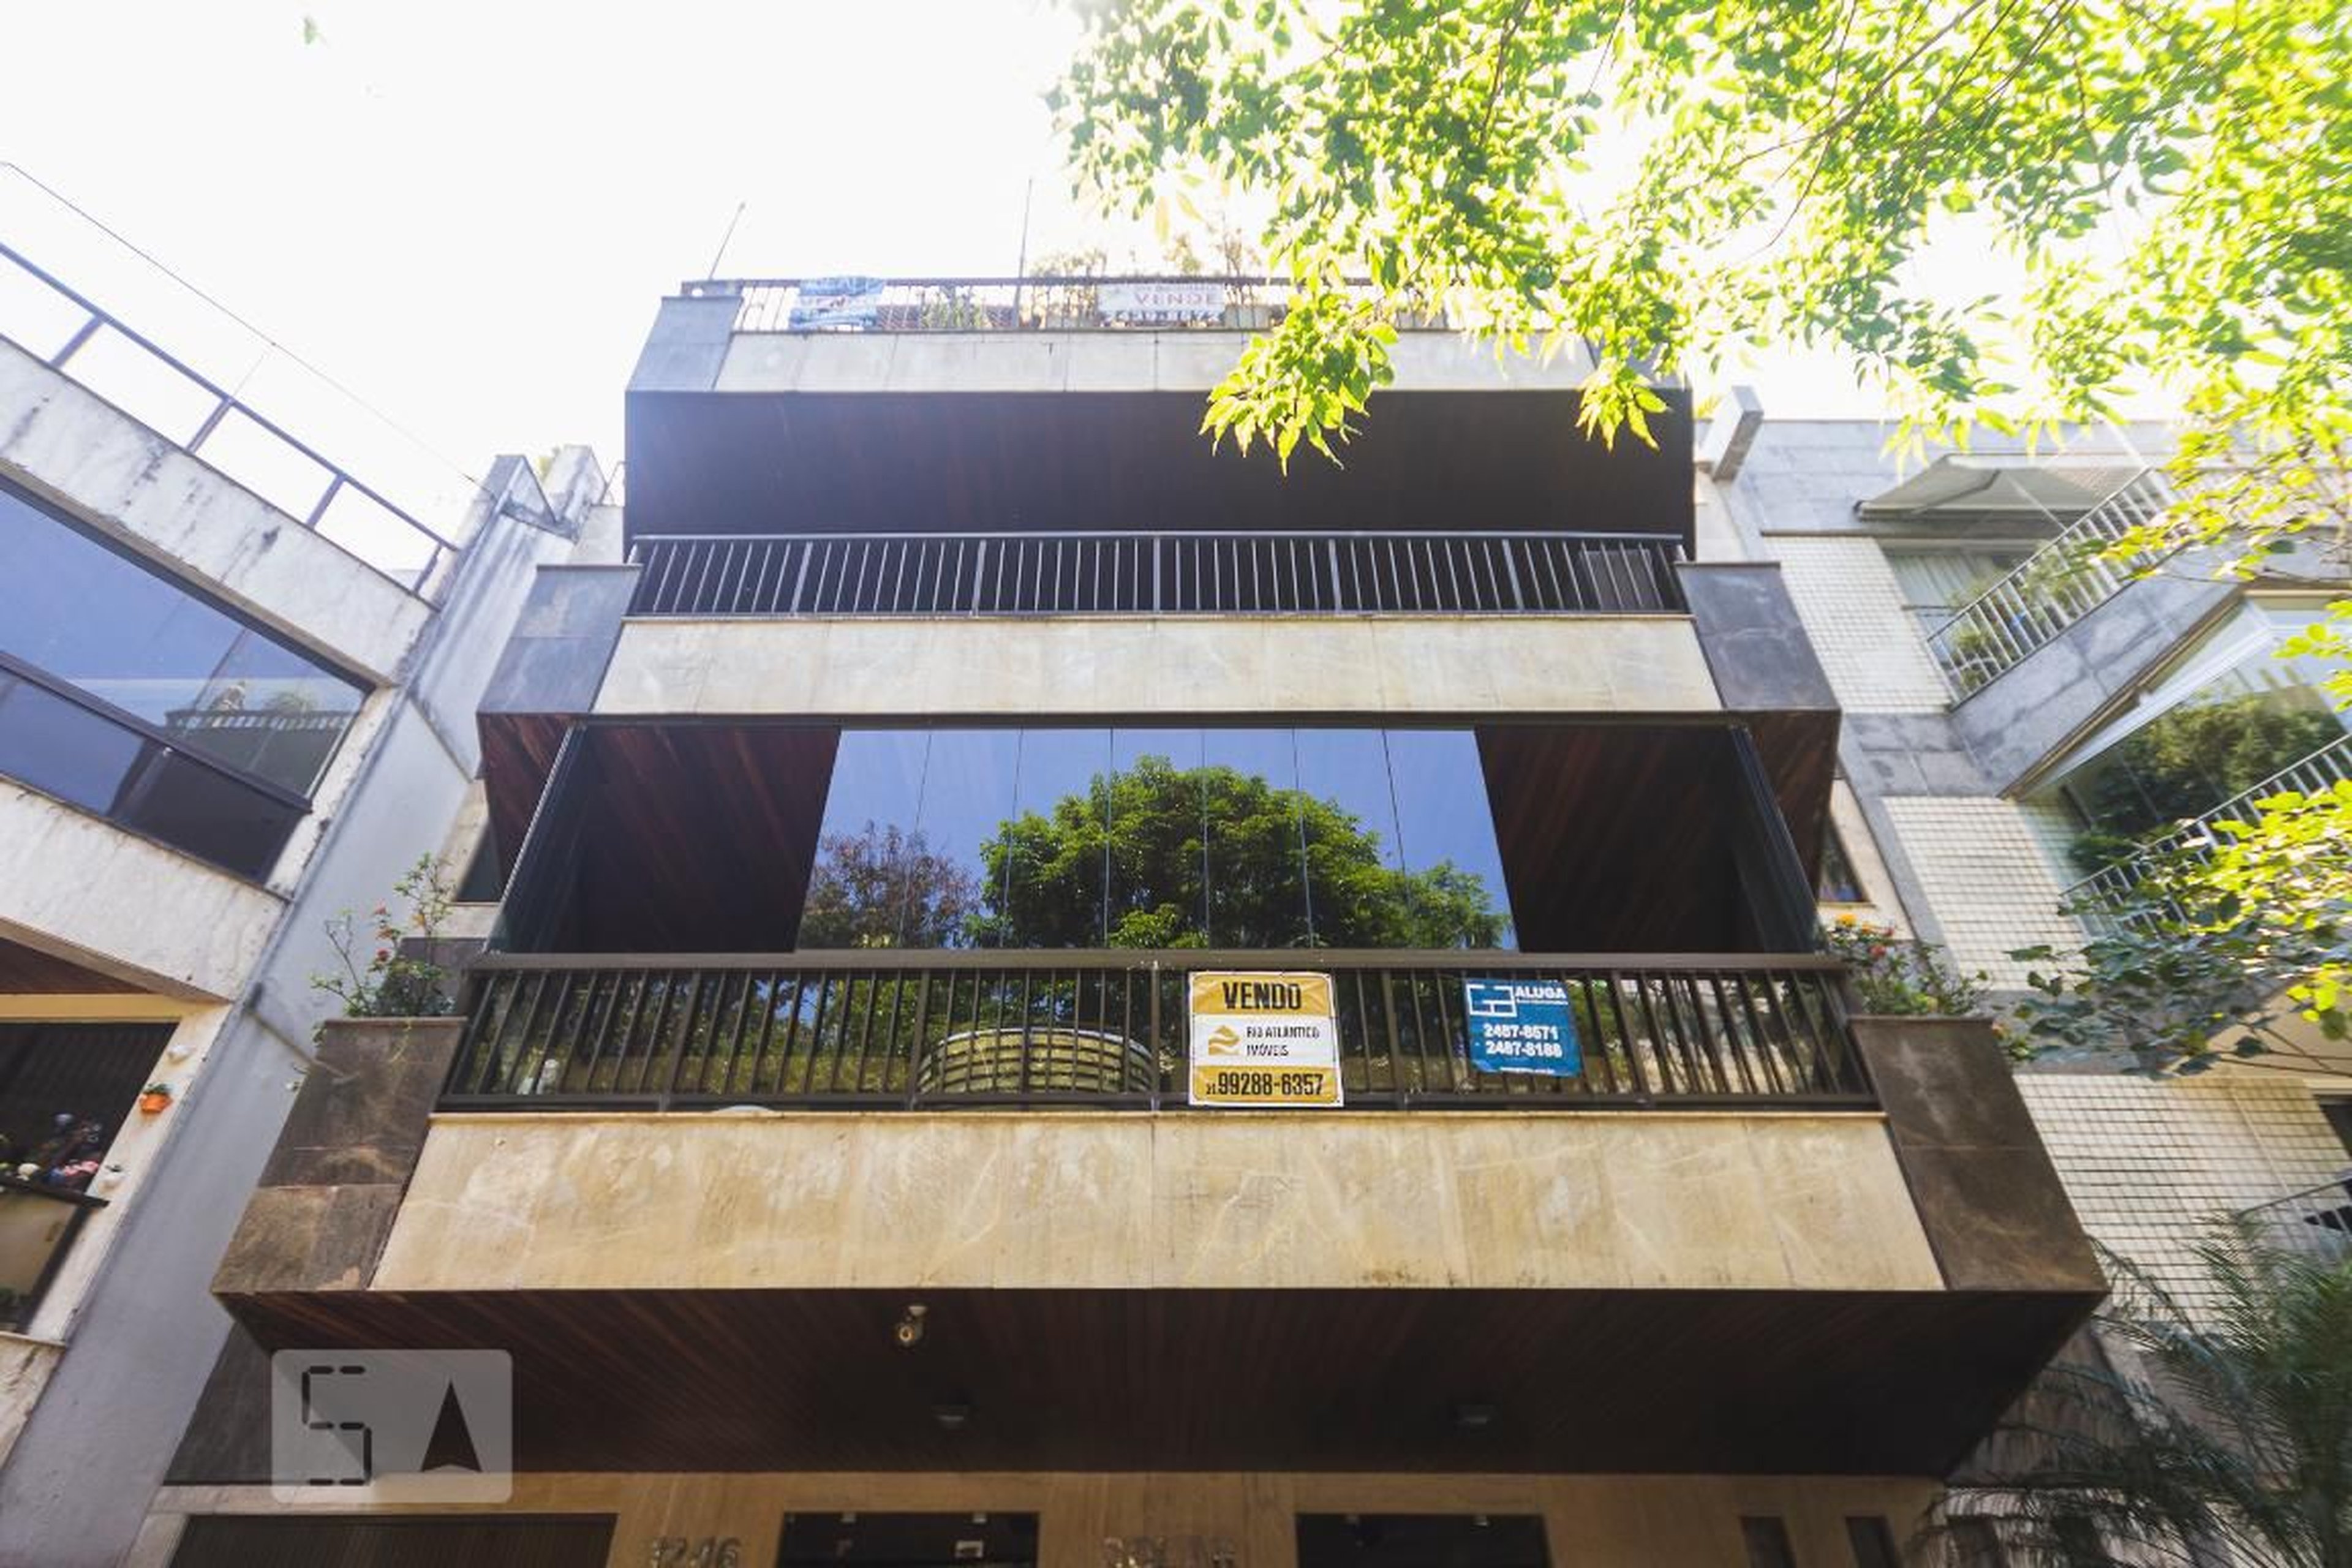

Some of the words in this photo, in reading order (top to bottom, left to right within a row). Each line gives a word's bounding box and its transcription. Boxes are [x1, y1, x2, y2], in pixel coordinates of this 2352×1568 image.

[1135, 293, 1222, 305] VENDE
[1223, 982, 1302, 1010] VENDO
[1515, 986, 1567, 1000] ALUGA
[1218, 1072, 1324, 1095] 99288-6357
